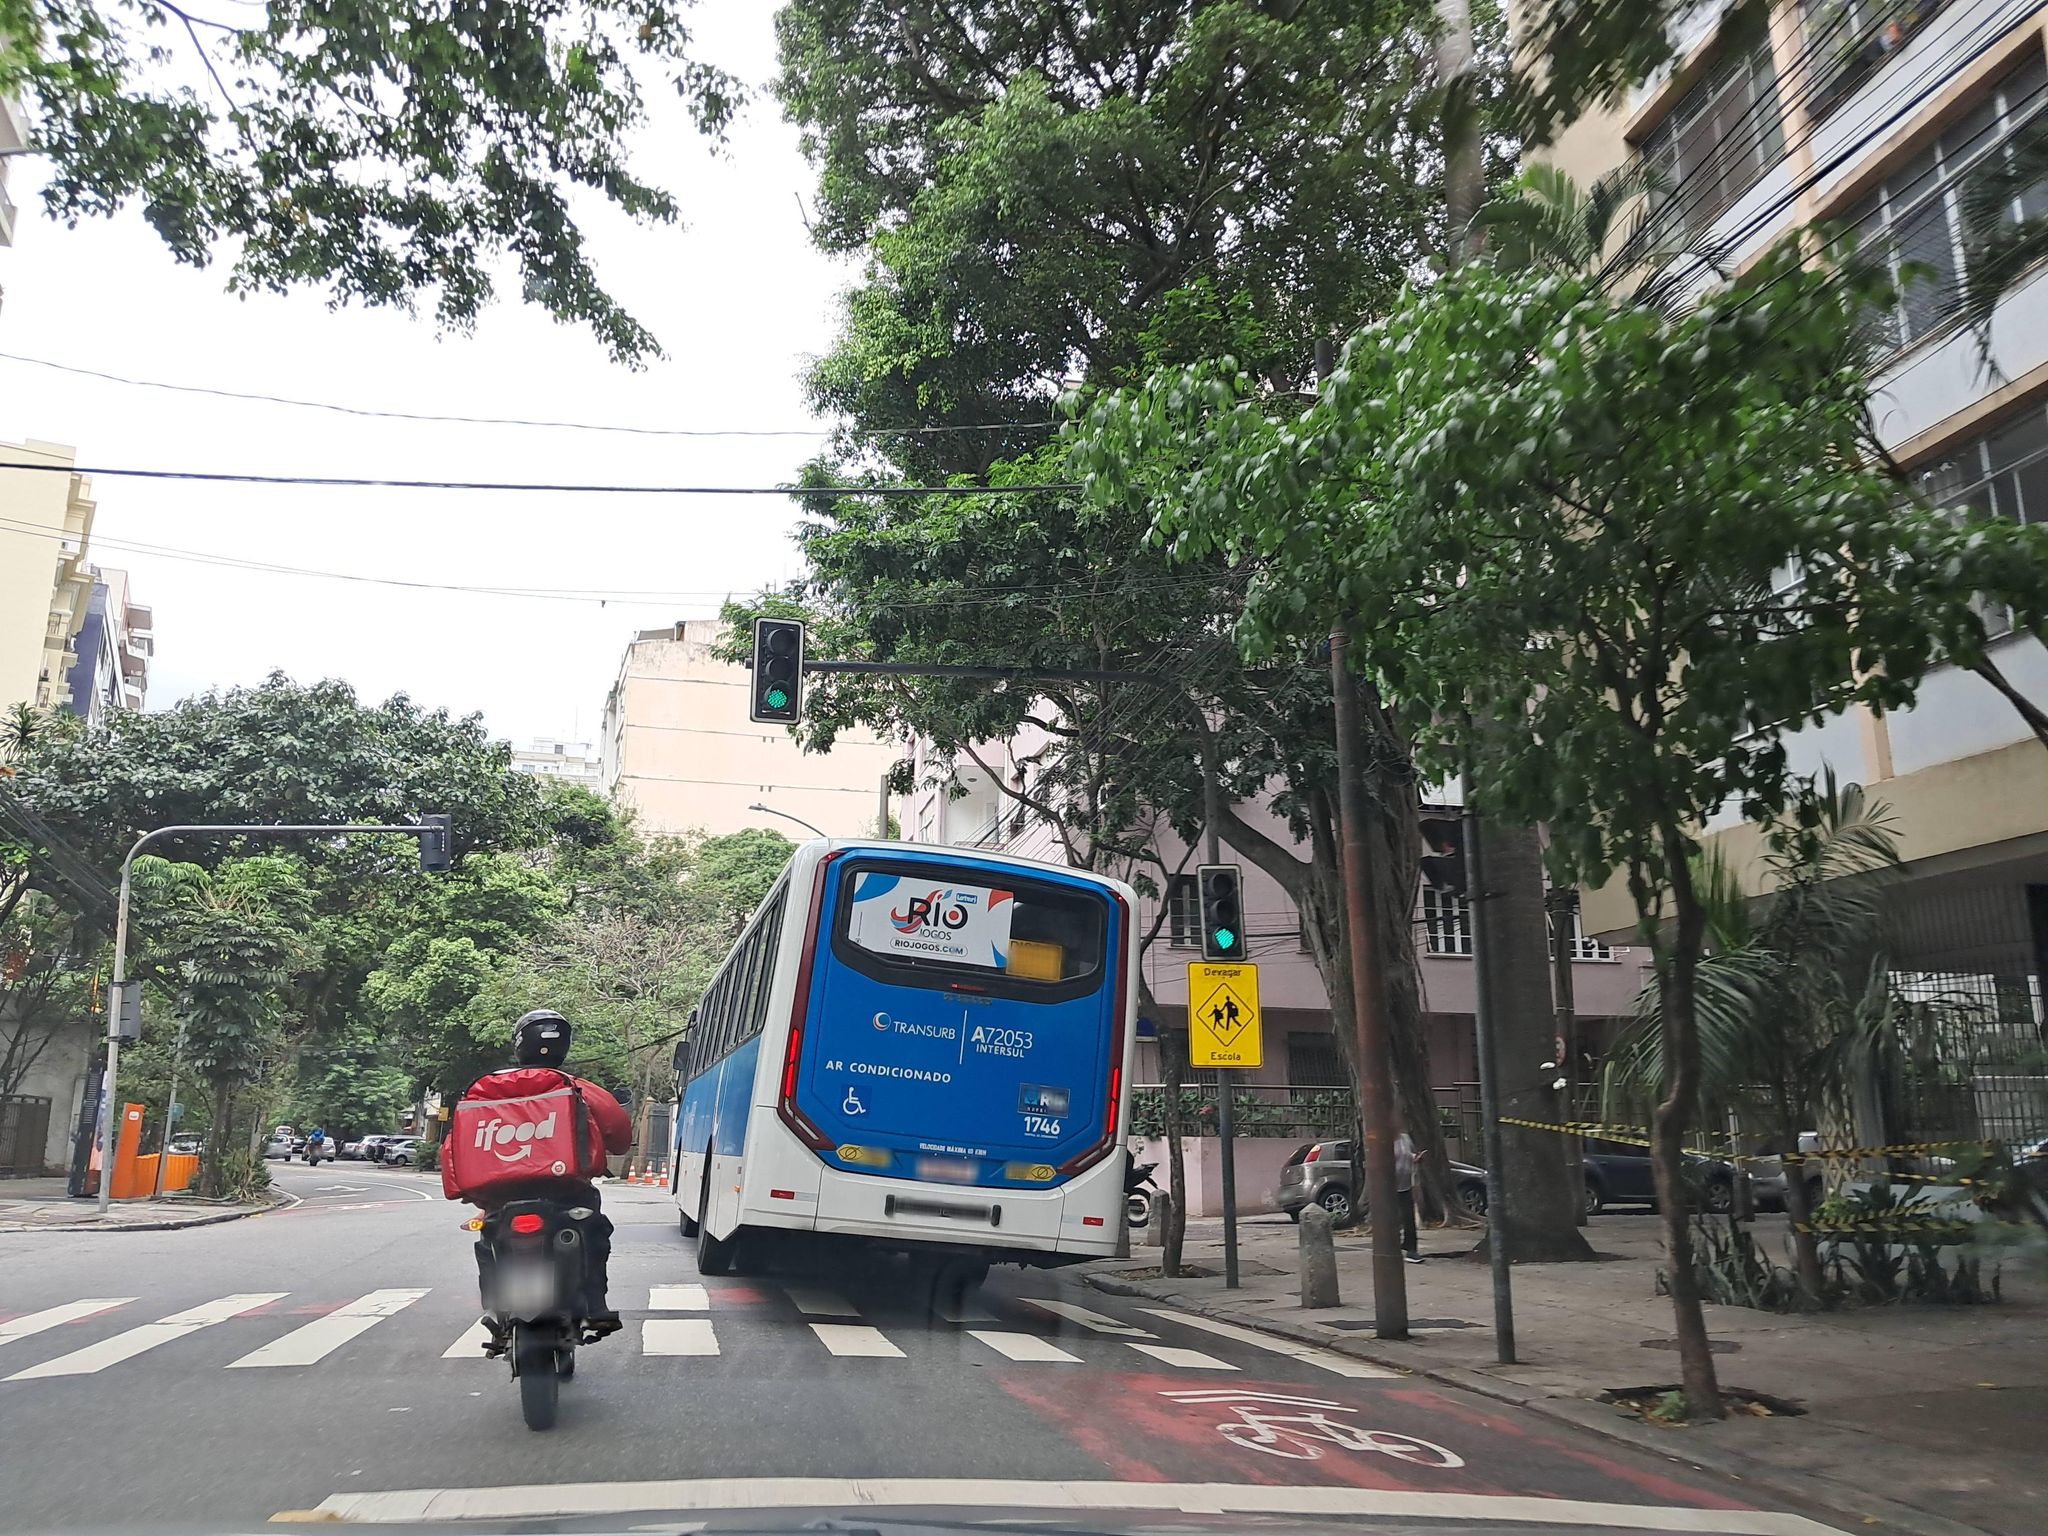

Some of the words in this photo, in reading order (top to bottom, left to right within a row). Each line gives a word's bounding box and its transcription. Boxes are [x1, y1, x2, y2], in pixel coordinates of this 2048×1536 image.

[919, 928, 952, 941] JOGOS
[894, 939, 964, 955] RIOJOGOS.COM
[1204, 968, 1242, 978] Devagar
[893, 1021, 956, 1040] TRANSURB
[970, 1025, 1033, 1049] A72053
[975, 1043, 1025, 1058] INTERSUL
[1211, 1052, 1241, 1061] Escola
[825, 1060, 843, 1071] AR
[849, 1062, 951, 1083] CONDICIONADO
[474, 1112, 557, 1151] ifood
[1024, 1116, 1060, 1135] 1746
